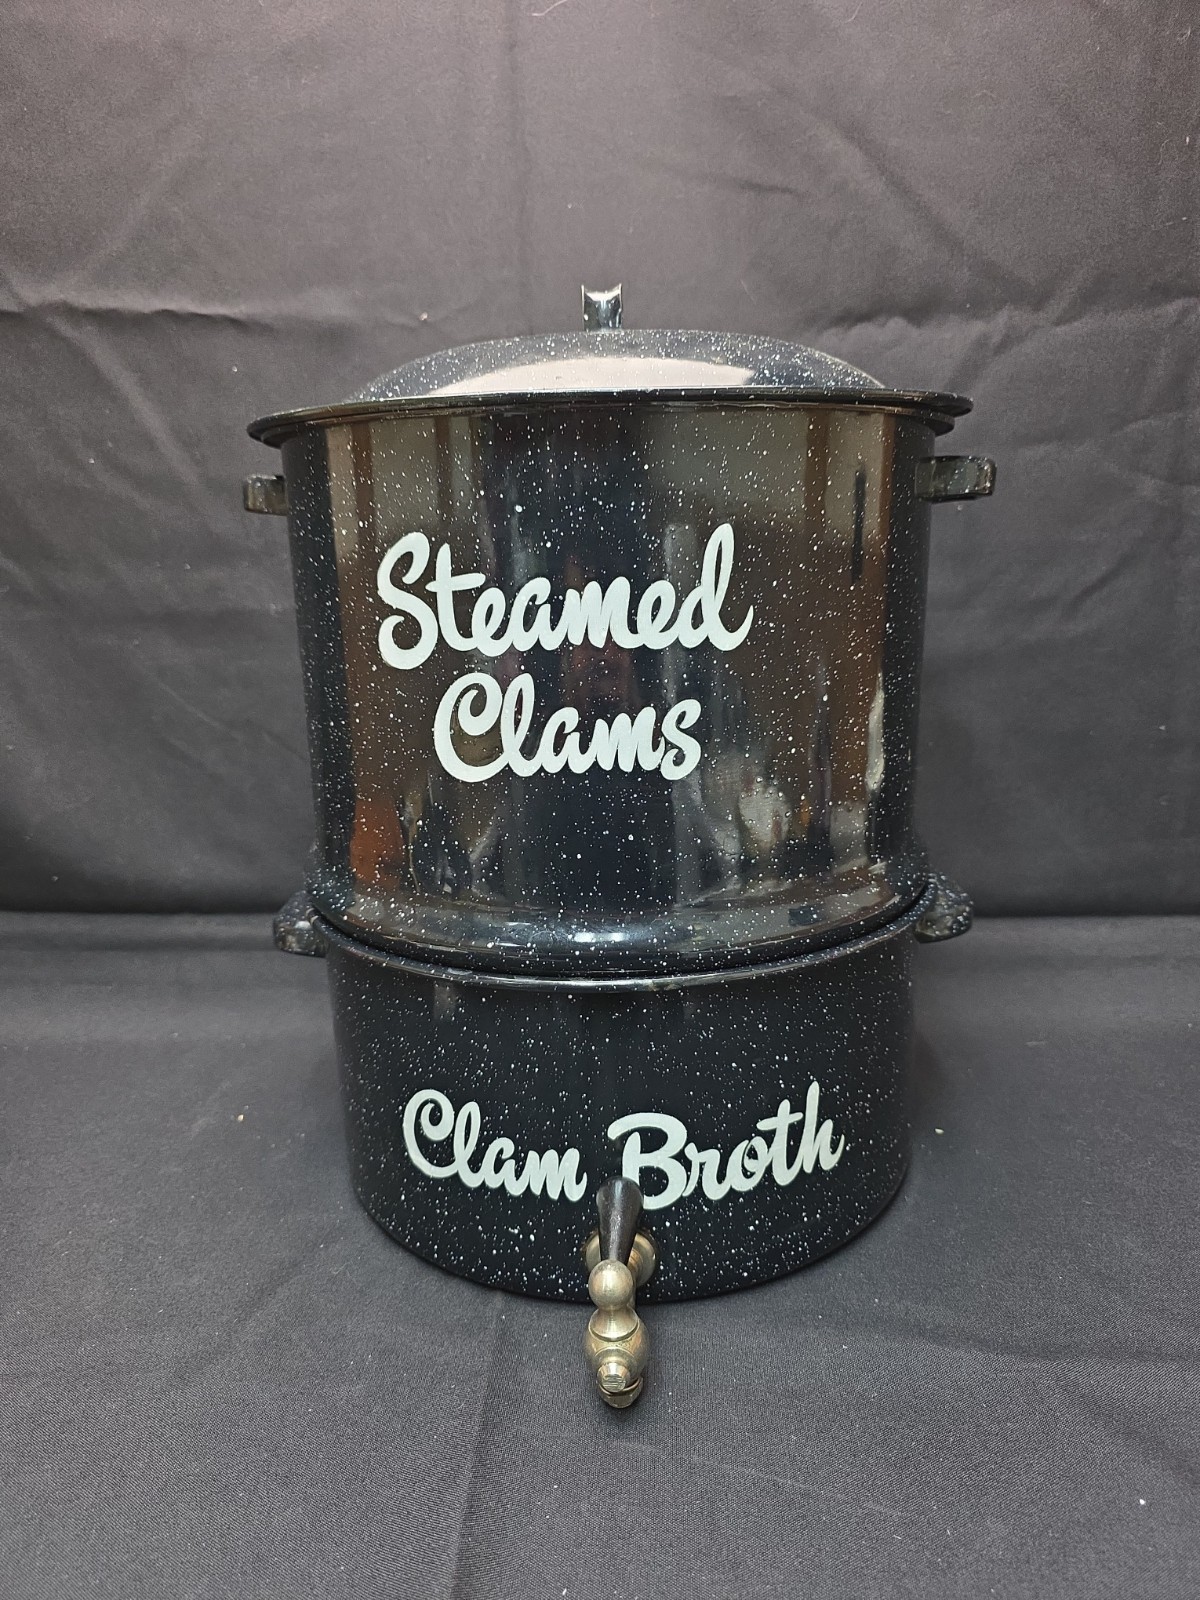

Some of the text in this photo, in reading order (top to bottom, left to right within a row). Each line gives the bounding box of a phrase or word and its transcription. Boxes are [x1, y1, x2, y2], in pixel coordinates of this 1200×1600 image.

[377, 523, 754, 670] Steamed
[432, 671, 702, 783] Clams
[403, 1081, 845, 1210] Clam Broth
